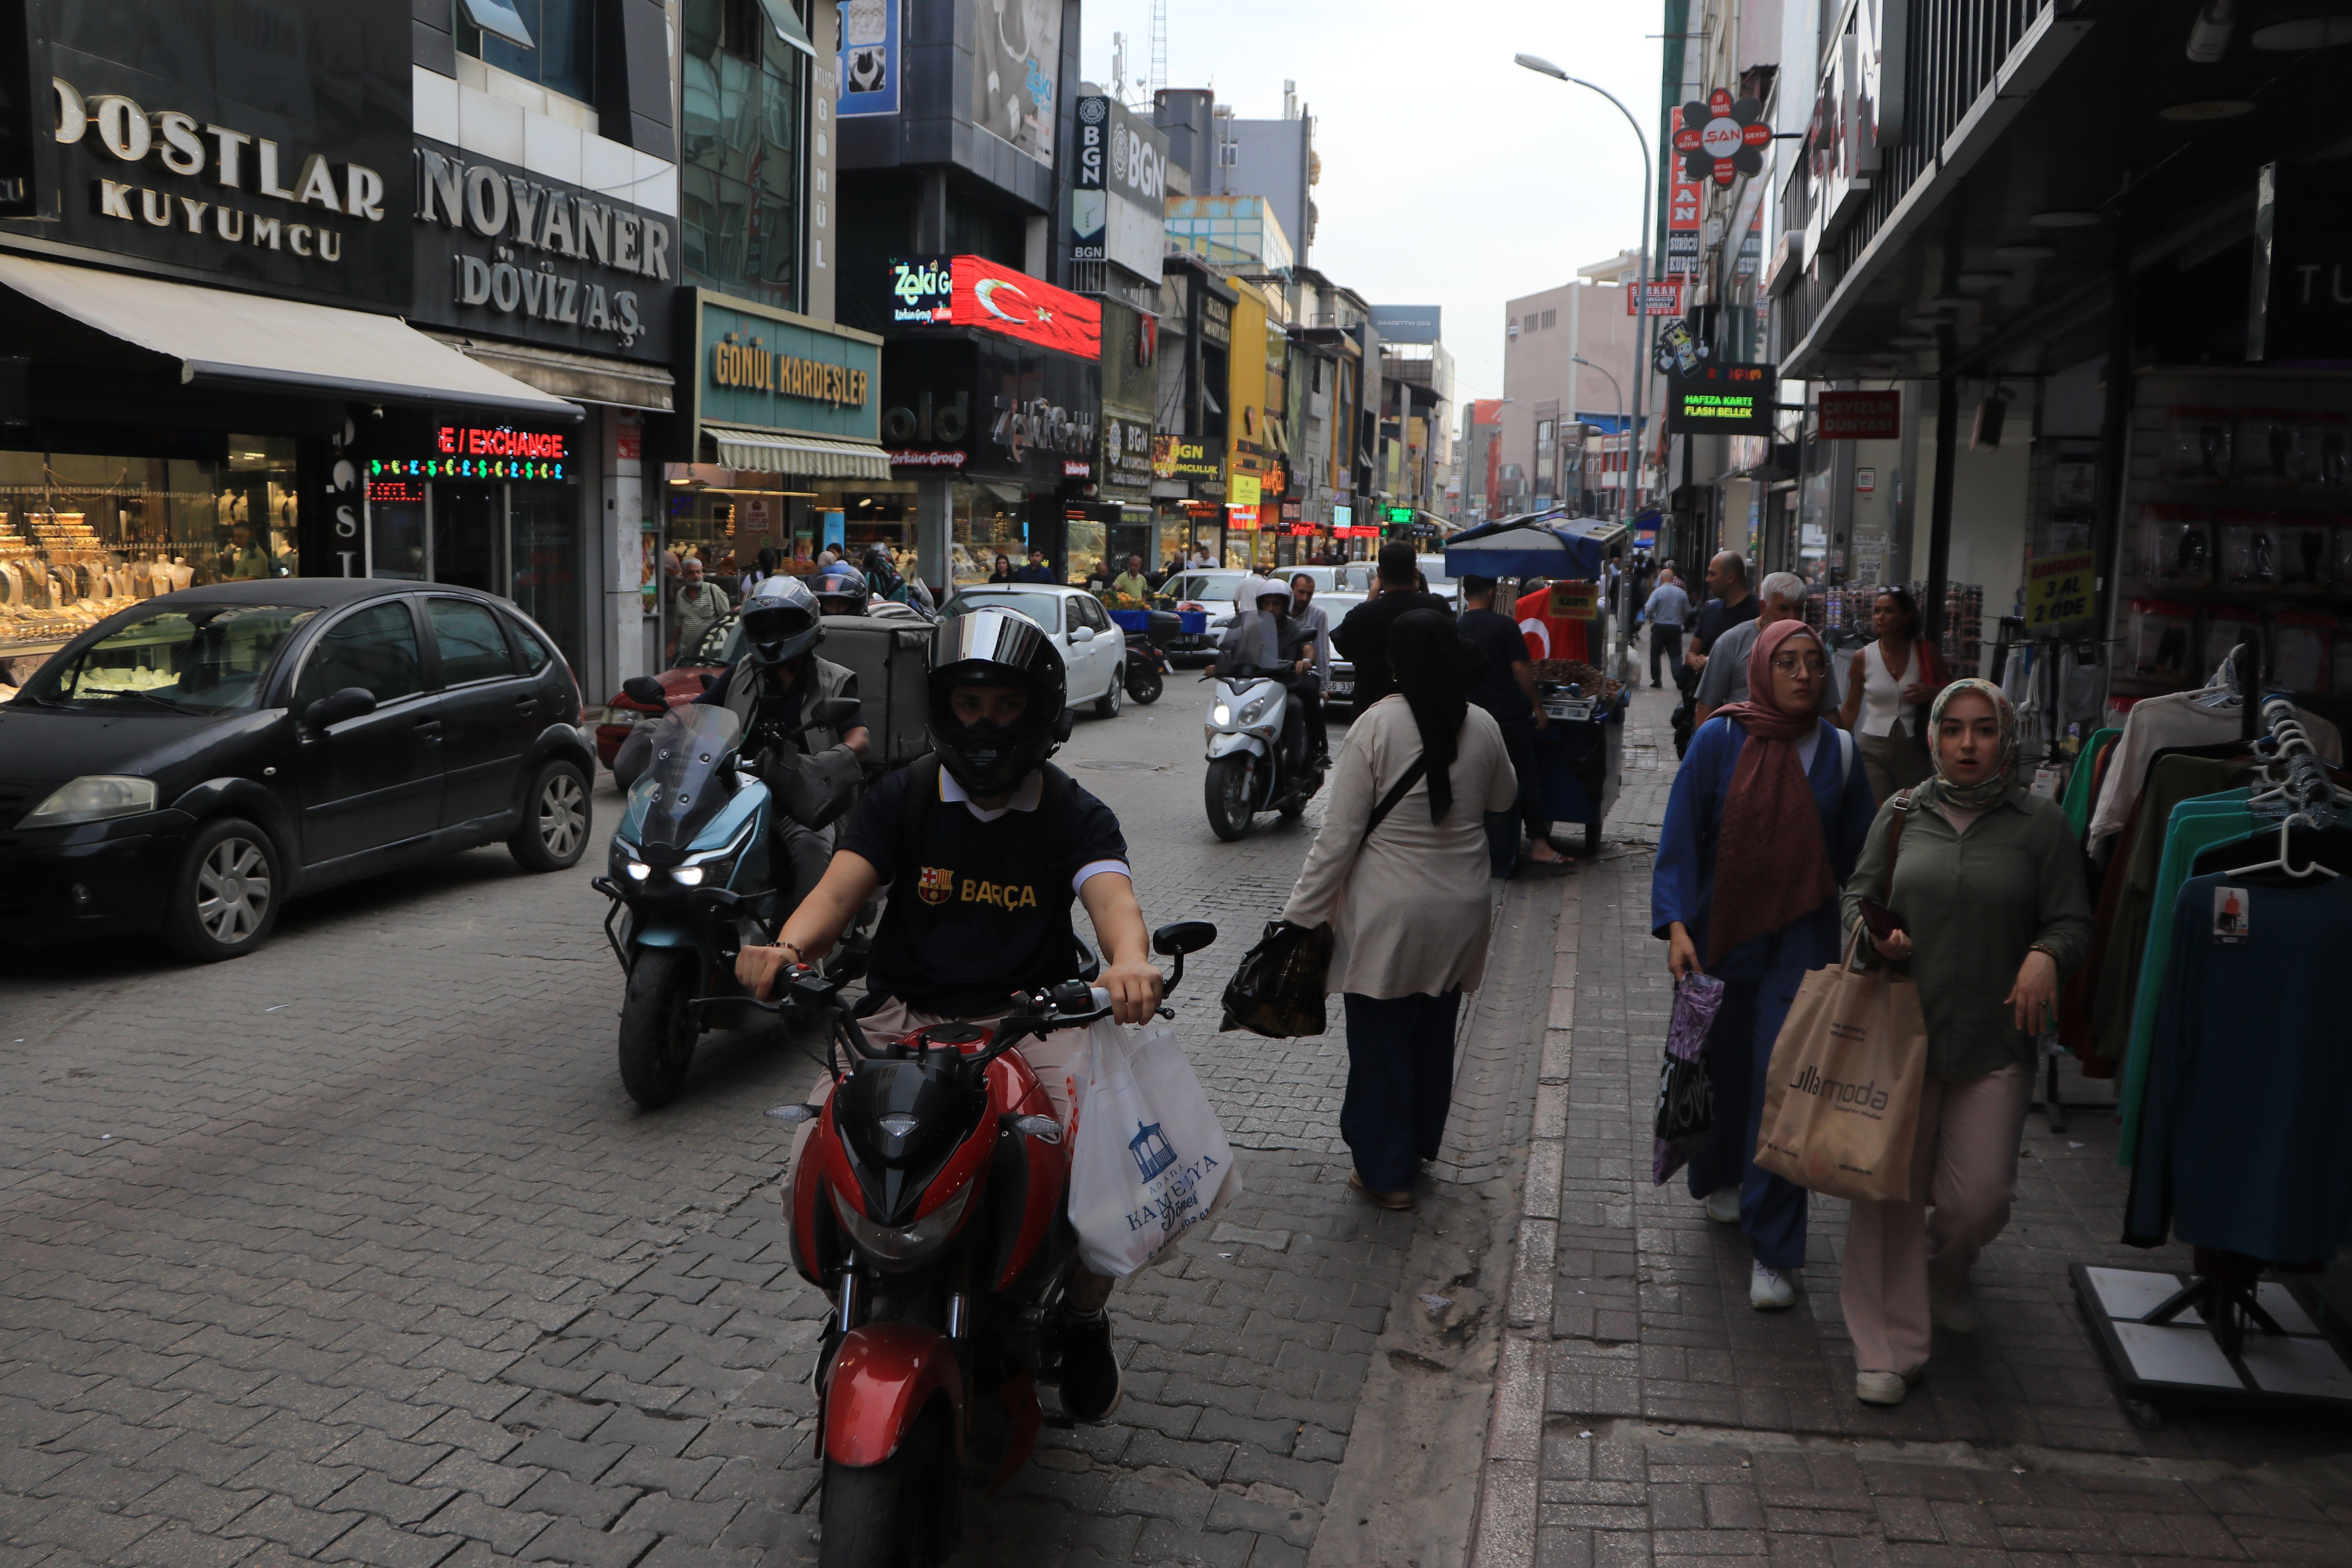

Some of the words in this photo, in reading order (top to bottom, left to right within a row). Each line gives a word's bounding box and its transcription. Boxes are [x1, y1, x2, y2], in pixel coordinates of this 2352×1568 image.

[1685, 134, 1692, 143] İÇ
[1704, 128, 1741, 145] ŞAN
[1746, 130, 1768, 140] ÇEYİZ
[1082, 126, 1101, 185] BGN
[1127, 130, 1165, 203] BGN
[101, 178, 341, 262] KUYUMCU
[420, 148, 670, 280] NOYANER
[1075, 247, 1102, 258] BGN
[457, 246, 578, 325] DÖVİZ
[895, 260, 938, 306] Zeki
[1632, 285, 1676, 295] SRKAN
[716, 333, 774, 390] GÖNÜL
[779, 354, 868, 409] KARDEŞLER
[1684, 395, 1721, 405] HAFIZA
[1723, 396, 1753, 406] KARTI
[1824, 399, 1895, 416] ÇEYİZLİK
[882, 390, 969, 444] old
[1684, 407, 1715, 416] FLASH
[1717, 407, 1752, 418] BELLEK
[1825, 417, 1893, 431] DÜNYASI
[469, 428, 564, 459] EXCHANGE
[1128, 425, 1148, 454] BGN
[929, 452, 964, 467] Group
[1170, 443, 1204, 459] BGN
[1153, 462, 1218, 474] KUYUMCULUK
[2031, 555, 2092, 579] KAMPANYA
[2046, 582, 2056, 598] 3
[2059, 577, 2080, 594] AL
[1559, 597, 1589, 607] KARTI
[2035, 606, 2045, 622] 2
[2050, 595, 2085, 618] ÖDE
[1341, 682, 1351, 691] 33
[961, 879, 1037, 912] BARÇA
[1125, 1155, 1219, 1231] KAMELYA
